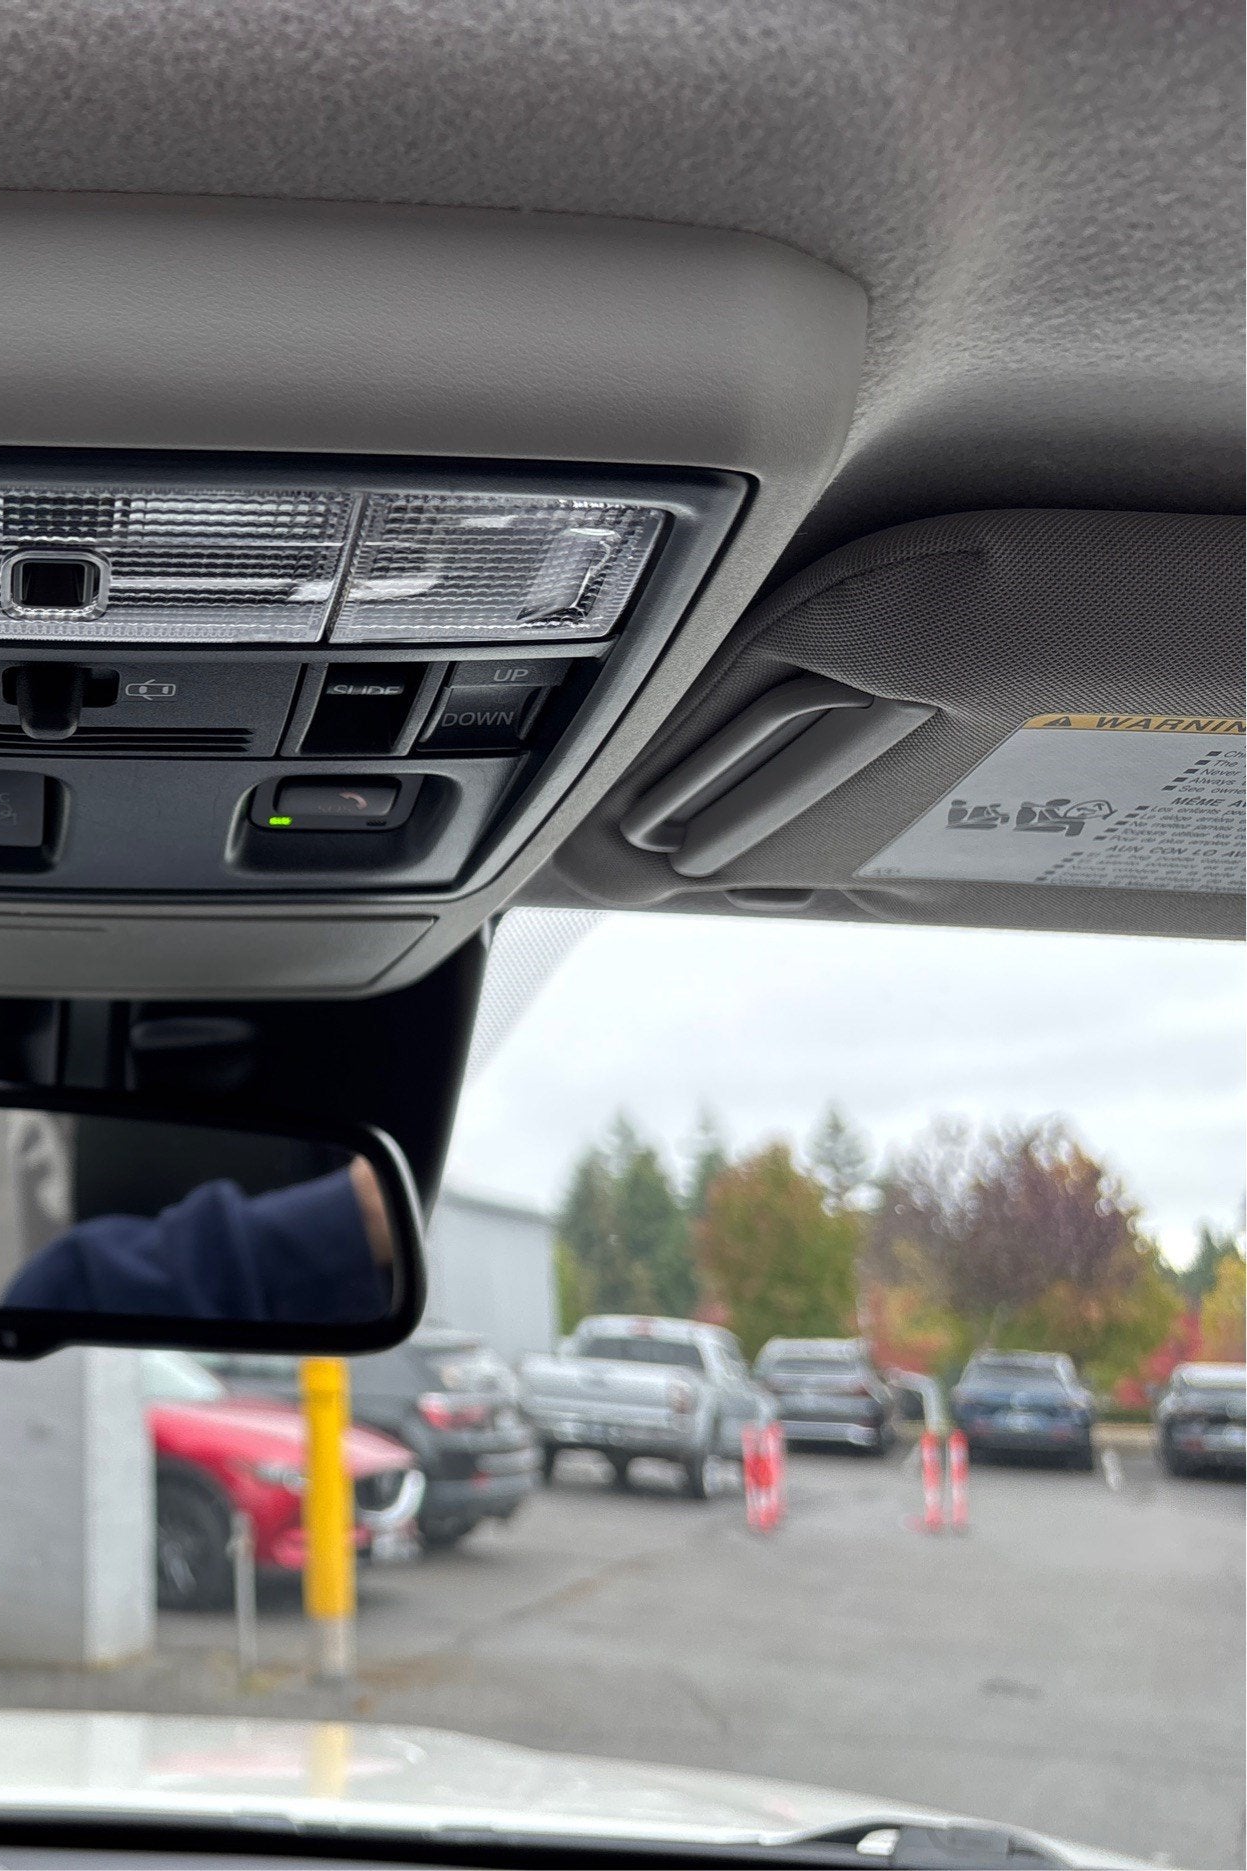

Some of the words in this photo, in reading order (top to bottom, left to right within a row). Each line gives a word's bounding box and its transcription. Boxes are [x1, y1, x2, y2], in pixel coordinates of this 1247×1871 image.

[492, 668, 530, 682] UP
[441, 712, 515, 728] DOWN
[1213, 759, 1239, 768] The
[1199, 768, 1242, 777] Never
[1187, 777, 1237, 786] Always
[1178, 785, 1206, 793] See
